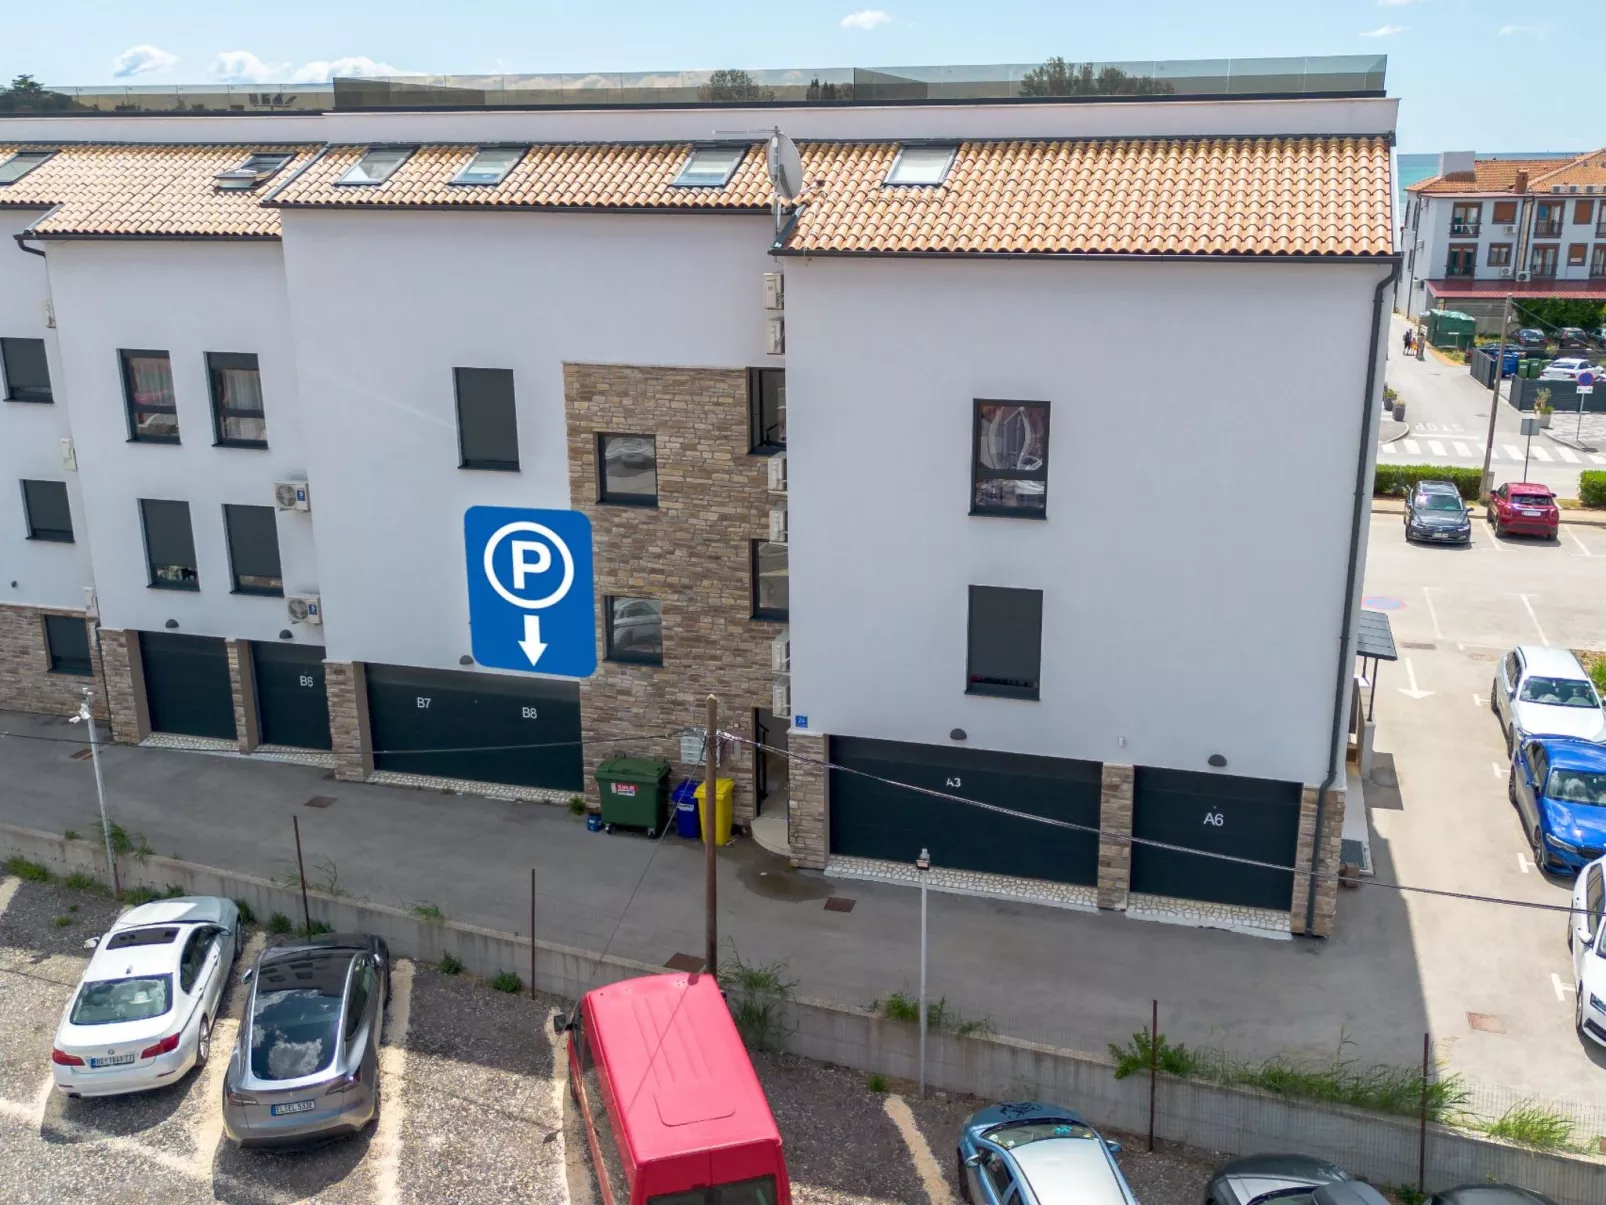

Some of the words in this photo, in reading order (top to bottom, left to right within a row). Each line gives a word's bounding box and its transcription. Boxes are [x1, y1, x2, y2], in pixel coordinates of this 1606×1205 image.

[511, 539, 553, 590] P
[299, 675, 314, 687] B6
[416, 696, 431, 709] B7
[522, 706, 538, 720] B8
[946, 777, 961, 788] A3
[1203, 812, 1225, 827] A6
